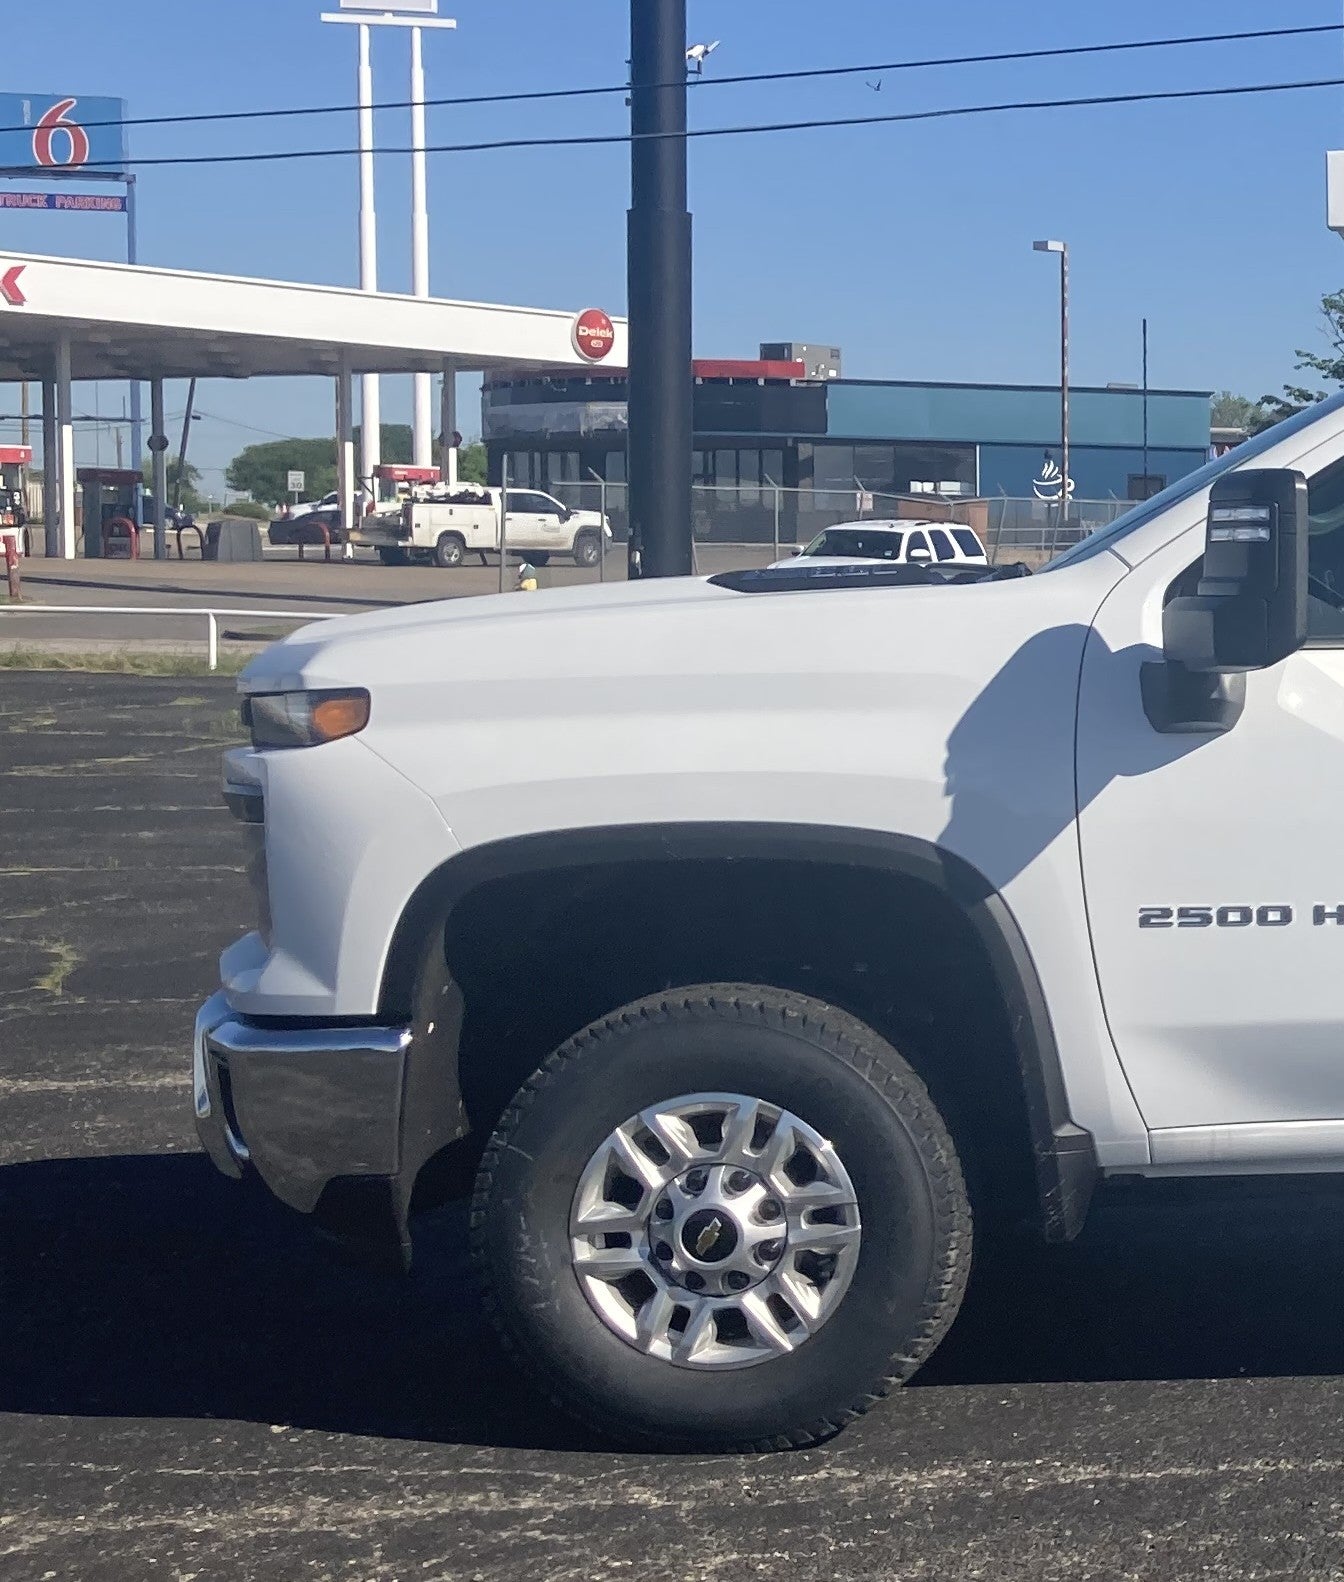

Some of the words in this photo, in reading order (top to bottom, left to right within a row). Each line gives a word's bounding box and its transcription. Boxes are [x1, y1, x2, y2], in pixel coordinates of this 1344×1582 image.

[32, 97, 90, 170] 6
[0, 193, 48, 208] TRUCK
[55, 194, 122, 211] PARKING
[578, 325, 613, 339] Delek
[1138, 905, 1293, 929] 2500
